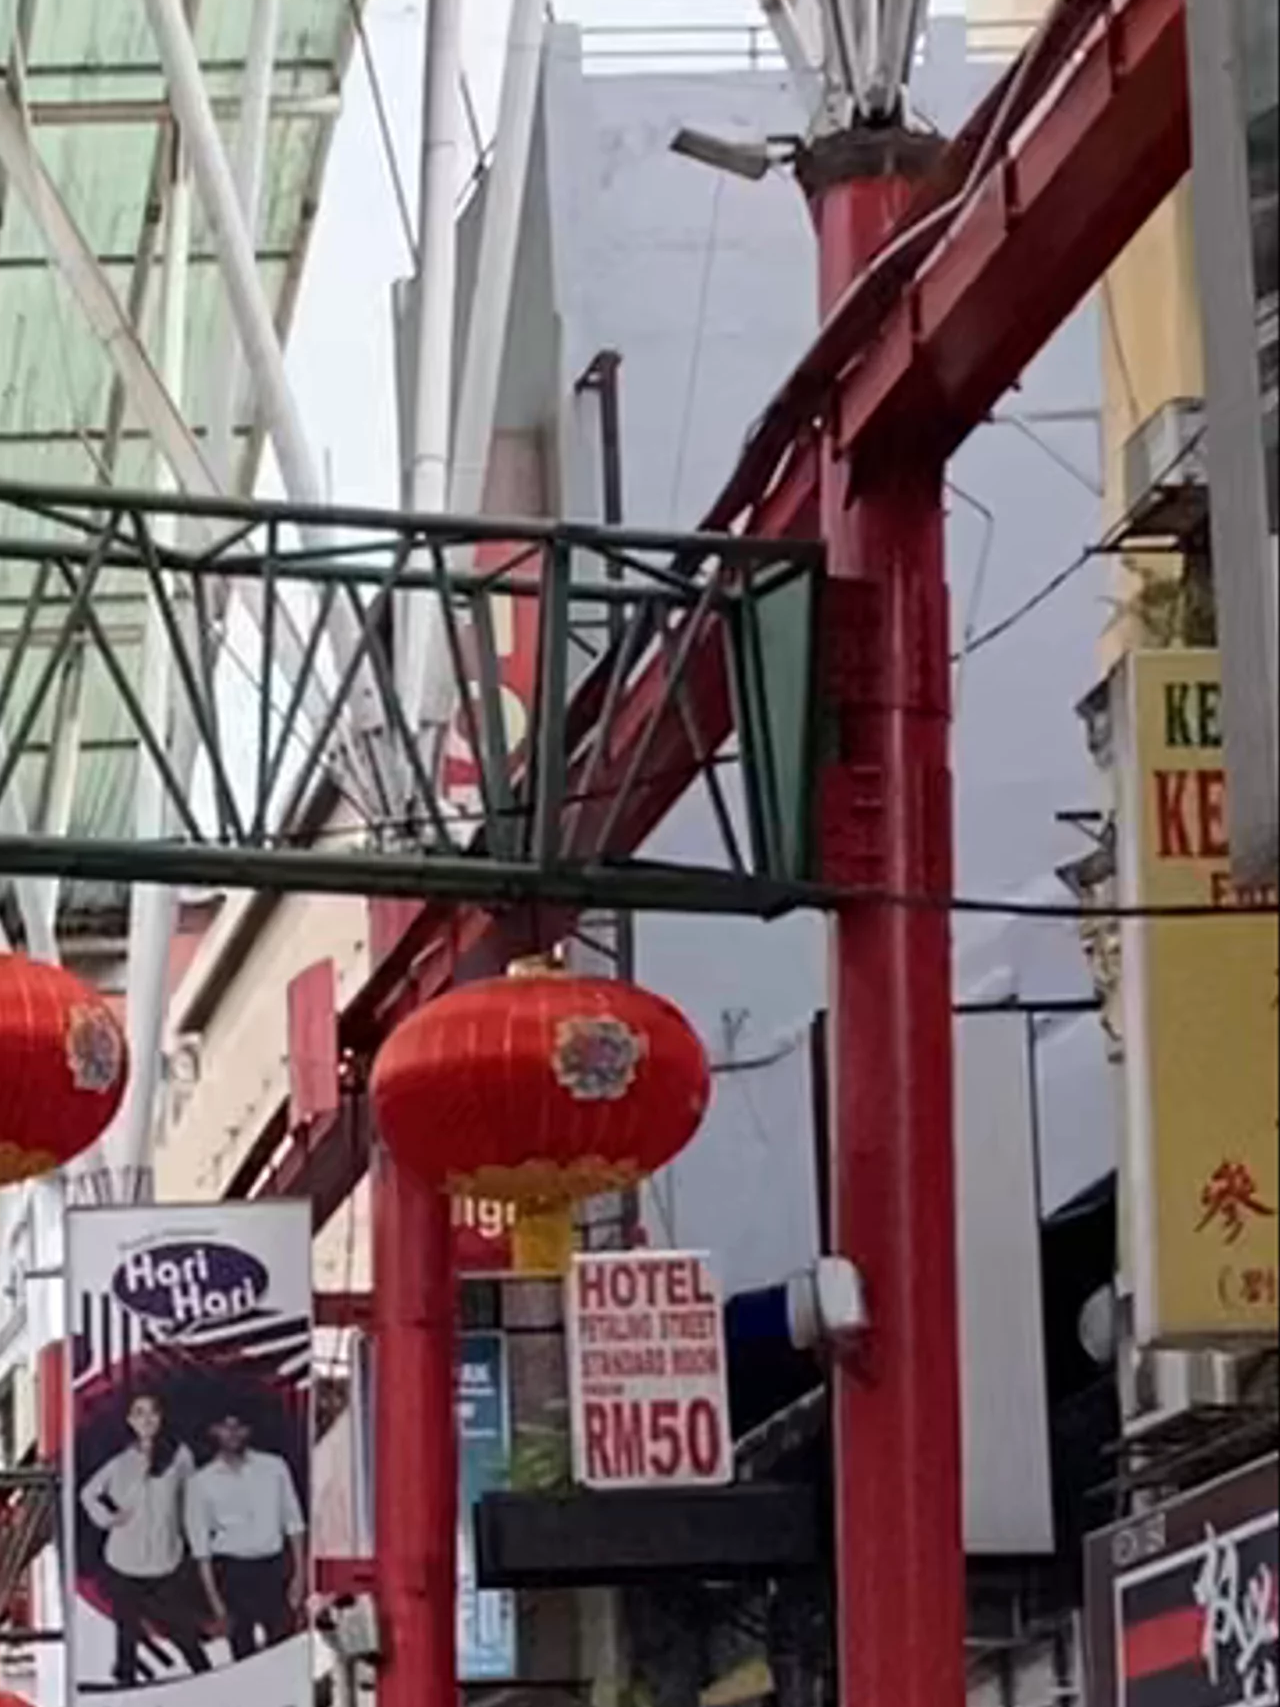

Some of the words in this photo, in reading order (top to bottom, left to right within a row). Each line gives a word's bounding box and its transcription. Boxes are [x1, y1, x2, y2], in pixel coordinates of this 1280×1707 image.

[123, 1249, 207, 1293] Hari
[578, 1258, 714, 1309] HOTEL
[172, 1278, 255, 1323] Hari
[583, 1397, 721, 1479] RM50
